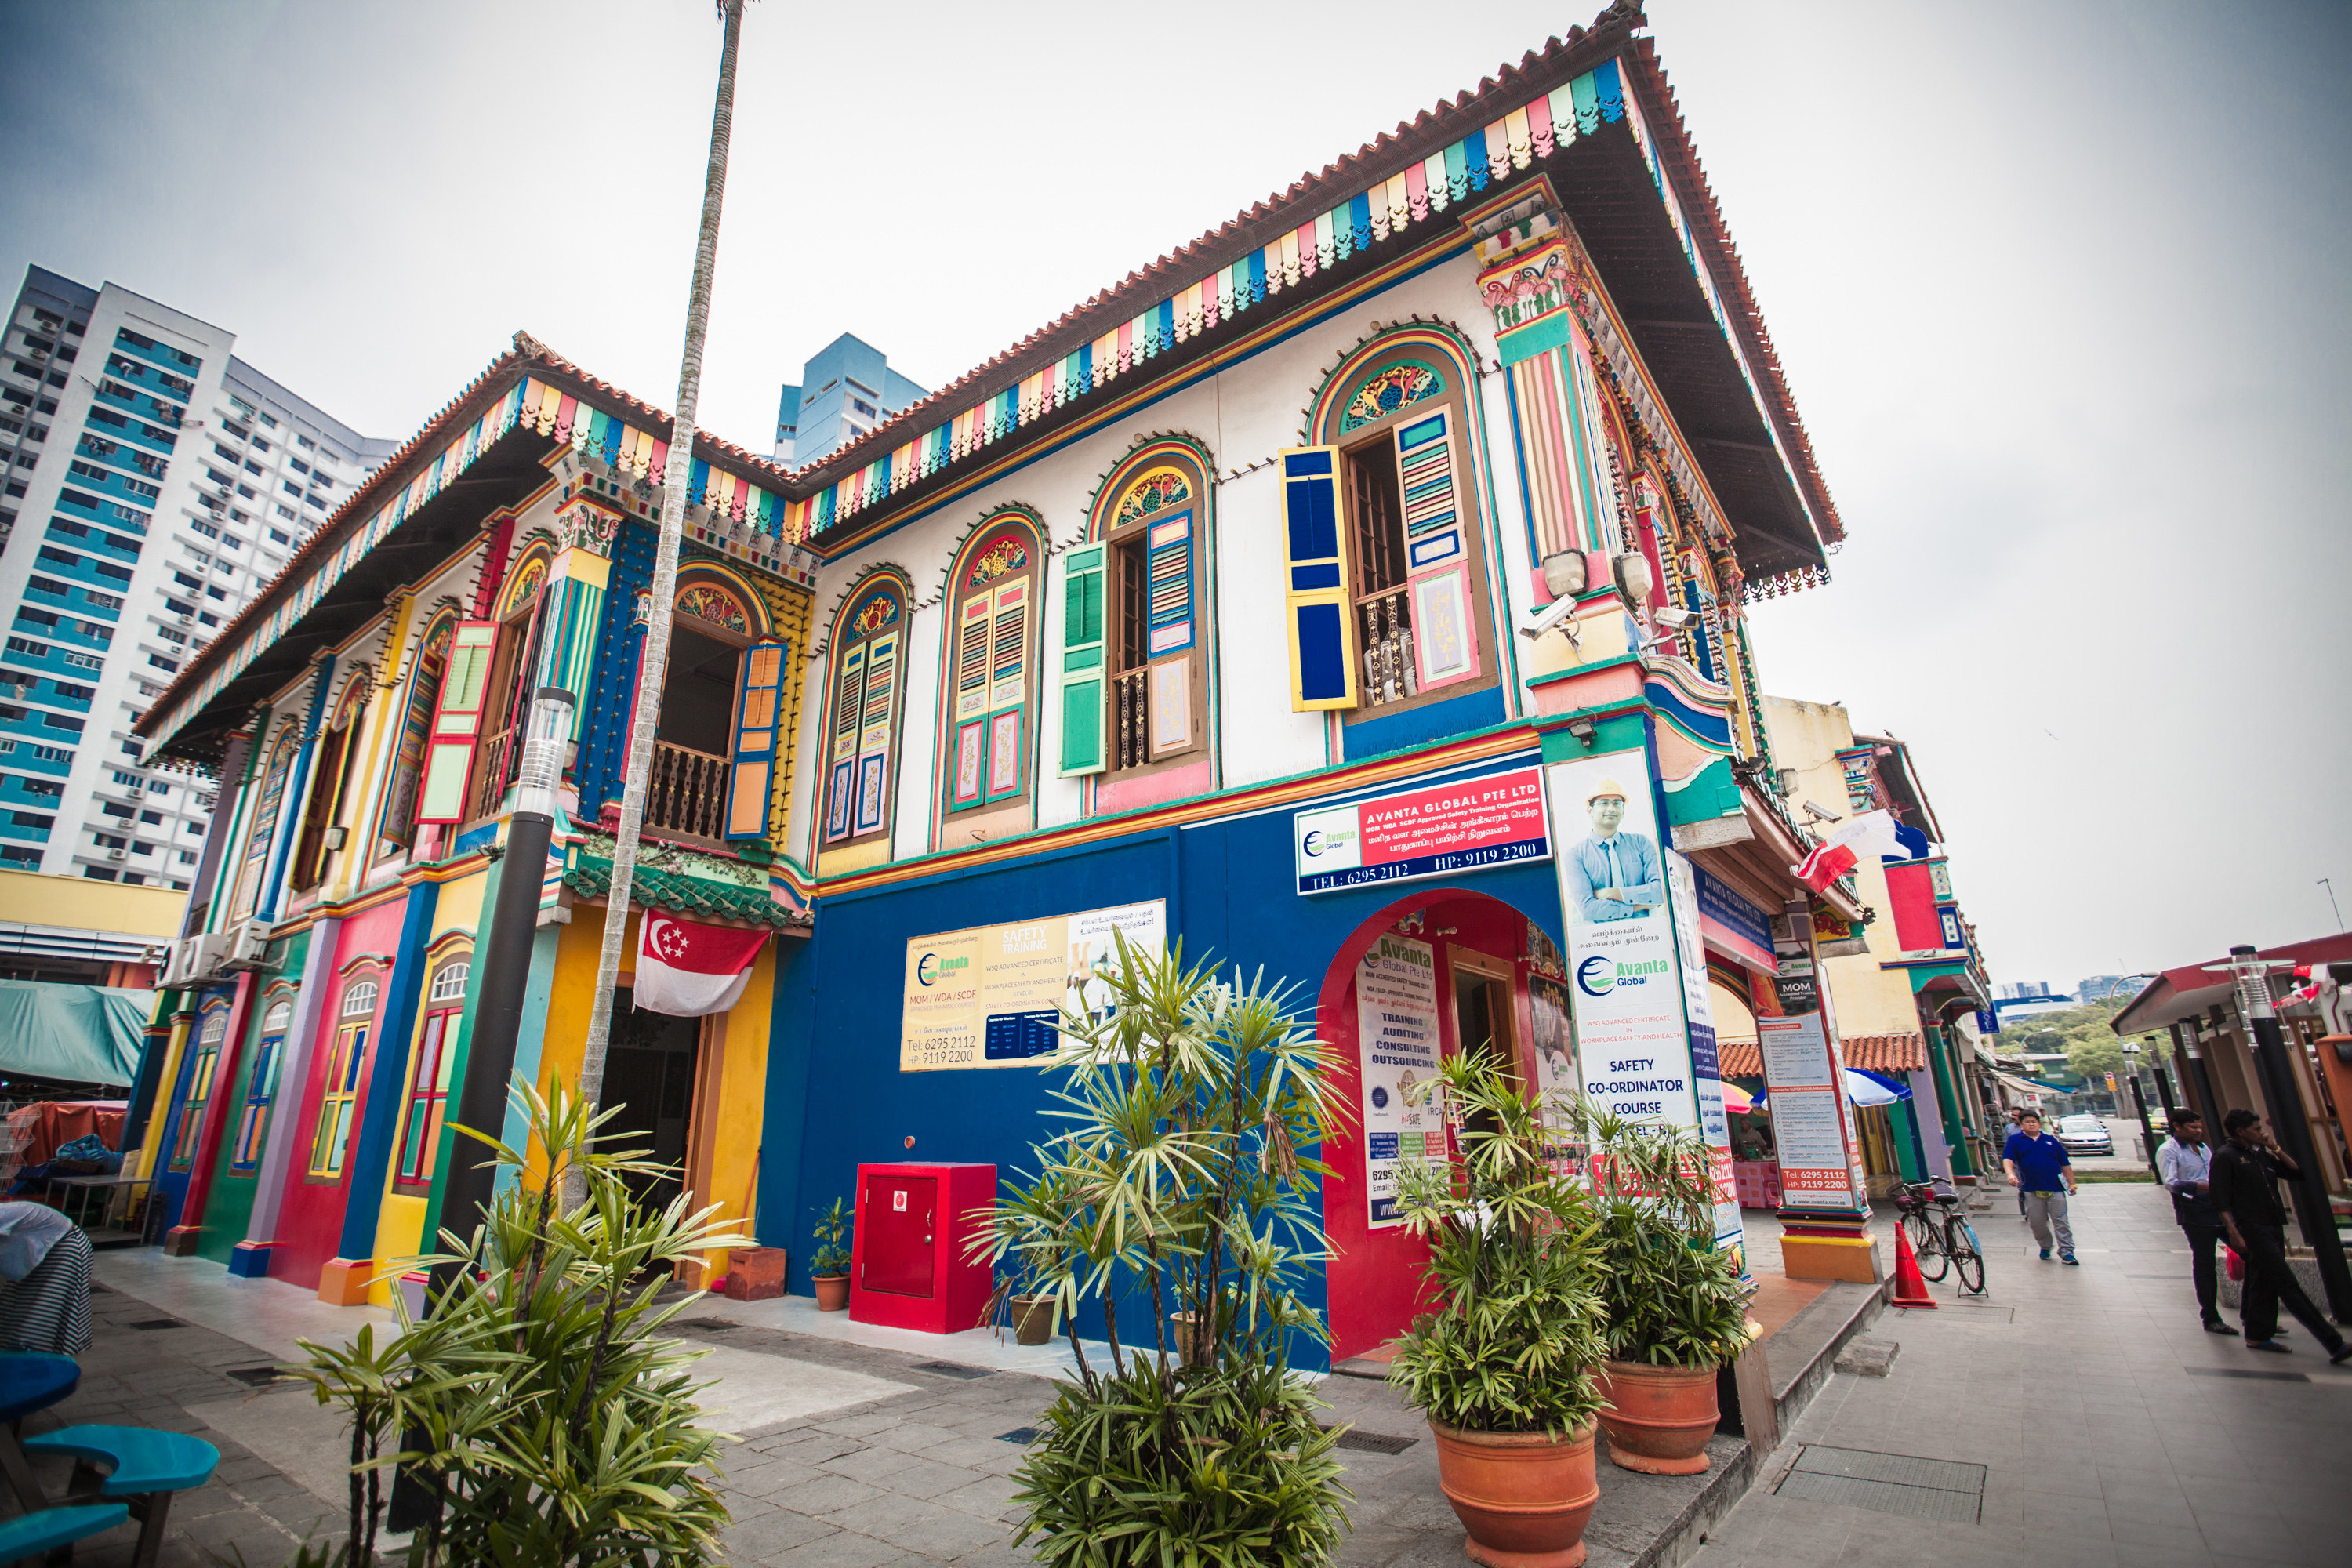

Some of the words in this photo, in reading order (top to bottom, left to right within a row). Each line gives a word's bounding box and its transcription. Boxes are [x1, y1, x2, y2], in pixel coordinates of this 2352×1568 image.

[1367, 807, 1419, 824] AVANTA
[1425, 795, 1478, 813] GLOBAL
[1483, 789, 1506, 802] PTE
[1512, 784, 1537, 797] LTD
[1399, 818, 1417, 827] SCDF
[1417, 812, 1446, 824] Approved
[1447, 809, 1468, 818] Safety
[1468, 805, 1496, 814] Training
[1497, 797, 1540, 809] Organization
[1327, 831, 1356, 843] Avanta
[1327, 841, 1344, 850] Global
[1435, 855, 1461, 871] HP:
[1465, 849, 1497, 866] 9119
[1503, 844, 1537, 860] 2200
[1311, 875, 1343, 890] TEL:
[1347, 869, 1377, 884] 6295
[1380, 863, 1409, 879] 2112
[1003, 925, 1047, 943] SAFETY
[1002, 939, 1047, 955] TRAINING
[1381, 938, 1431, 968] Avanta
[940, 956, 968, 971] Avanta
[999, 960, 1029, 970] ADVANCED
[1029, 956, 1064, 967] CERTIFICATE
[1383, 959, 1407, 973] Global
[1410, 965, 1421, 977] Pte
[1421, 969, 1432, 980] Ltd
[1617, 960, 1668, 977] Avanta
[1617, 976, 1647, 986] Global
[1783, 982, 1811, 992] MOM
[910, 995, 928, 1004] MOM
[934, 992, 952, 1002] WDA
[957, 989, 976, 1000] SCDF
[1381, 1013, 1423, 1026] TRAINING
[1634, 1014, 1671, 1023] CERTIFICATE
[1383, 1027, 1424, 1040] AUDITING
[908, 1040, 923, 1051] Tel:
[925, 1036, 949, 1051] 6295
[950, 1035, 975, 1048] 2112
[1376, 1040, 1431, 1054] CONSULTING
[908, 1054, 920, 1065] HP:
[923, 1051, 946, 1064] 9119
[948, 1050, 973, 1062] 2200
[1372, 1054, 1435, 1069] OUTSOURCING
[1610, 1058, 1654, 1073] SAFETY
[1588, 1079, 1684, 1094] CO-ORDINATOR
[1428, 1107, 1443, 1116] IRCA
[1613, 1102, 1662, 1115] COURSE
[1373, 1169, 1393, 1181] 6295
[1721, 1163, 1733, 1180] 2112
